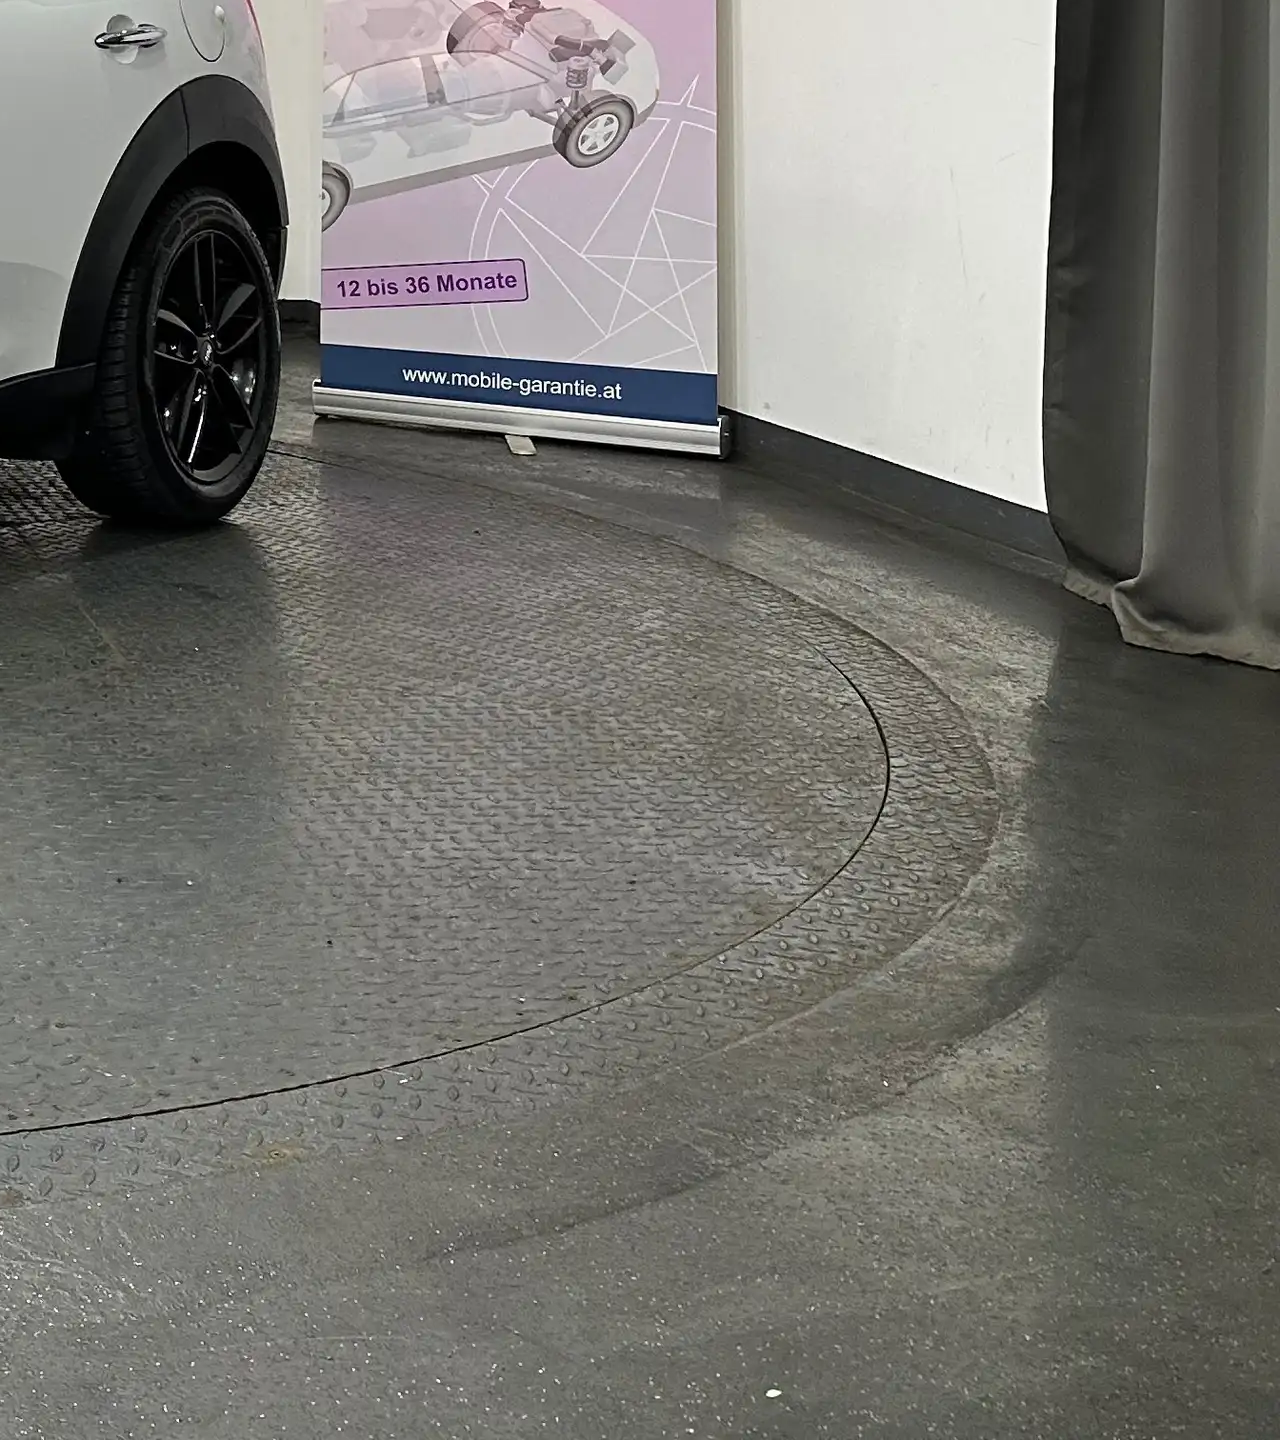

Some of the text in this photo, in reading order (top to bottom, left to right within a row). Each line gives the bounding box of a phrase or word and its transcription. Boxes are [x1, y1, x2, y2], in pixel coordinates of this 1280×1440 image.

[336, 271, 518, 298] 12 bis 36 Monate
[402, 367, 623, 400] www.mobile-garantie.at
